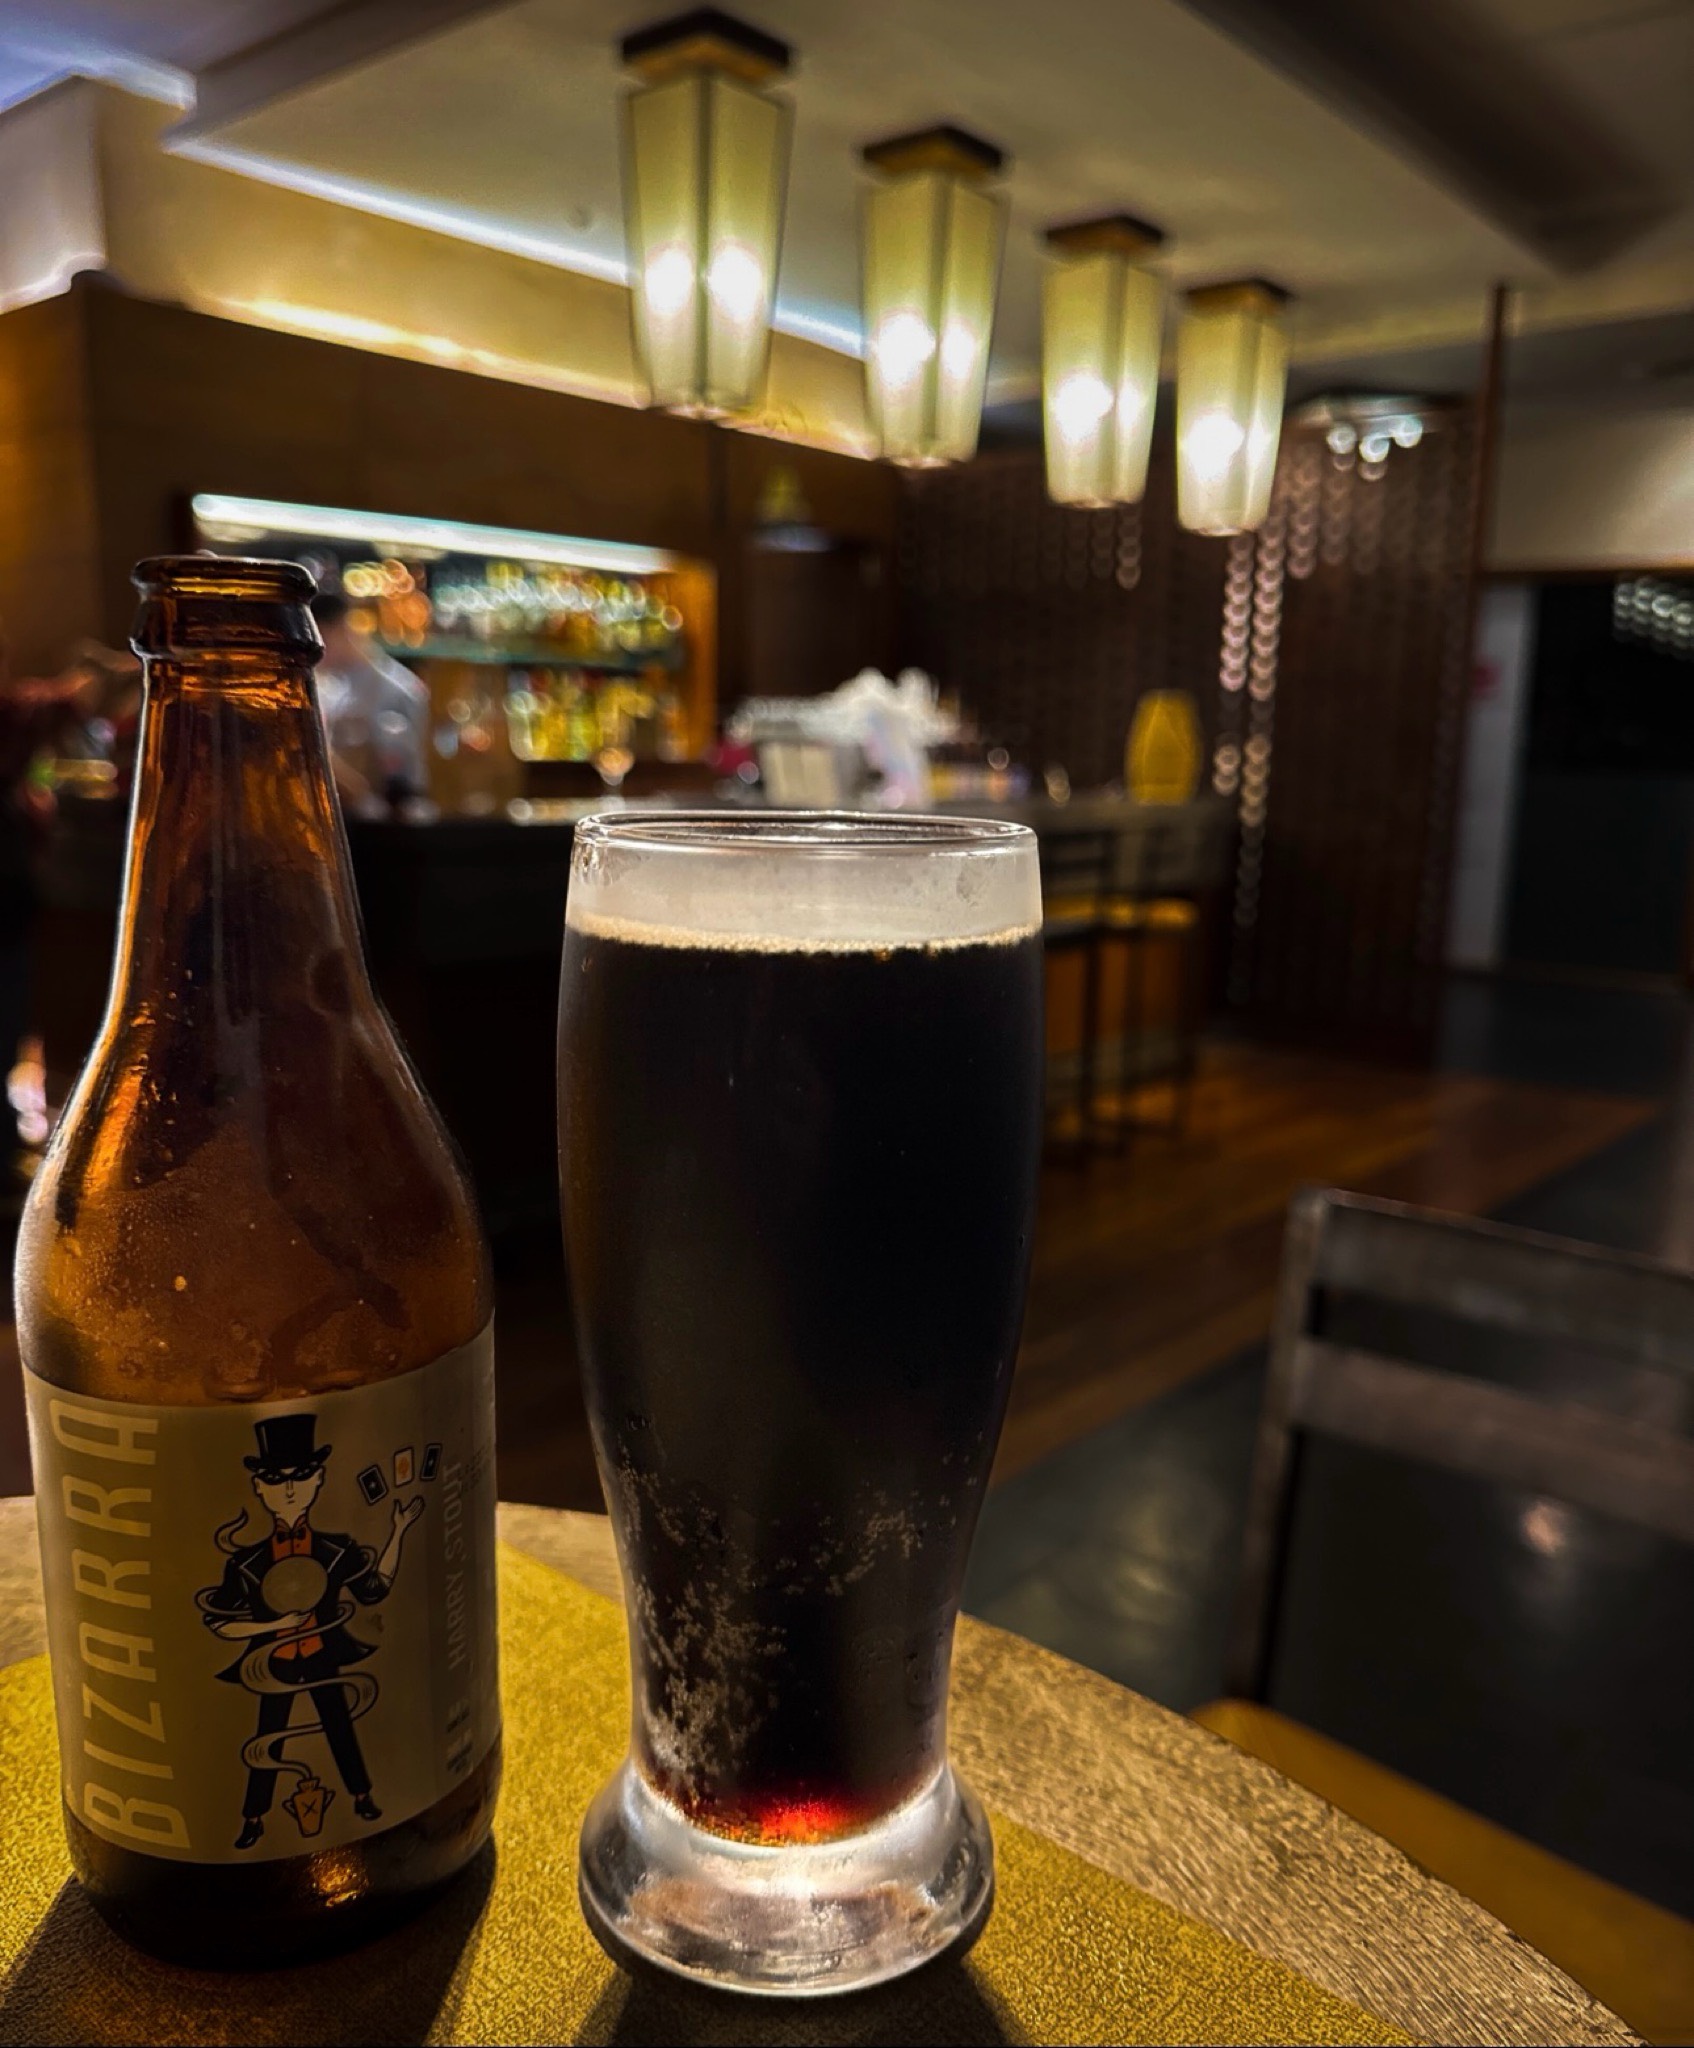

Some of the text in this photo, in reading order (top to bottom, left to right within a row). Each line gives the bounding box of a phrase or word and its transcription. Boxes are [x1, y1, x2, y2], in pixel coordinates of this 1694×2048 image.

[50, 1398, 192, 1850] BIZARRA
[443, 1462, 467, 1671] HARRY STOUT
